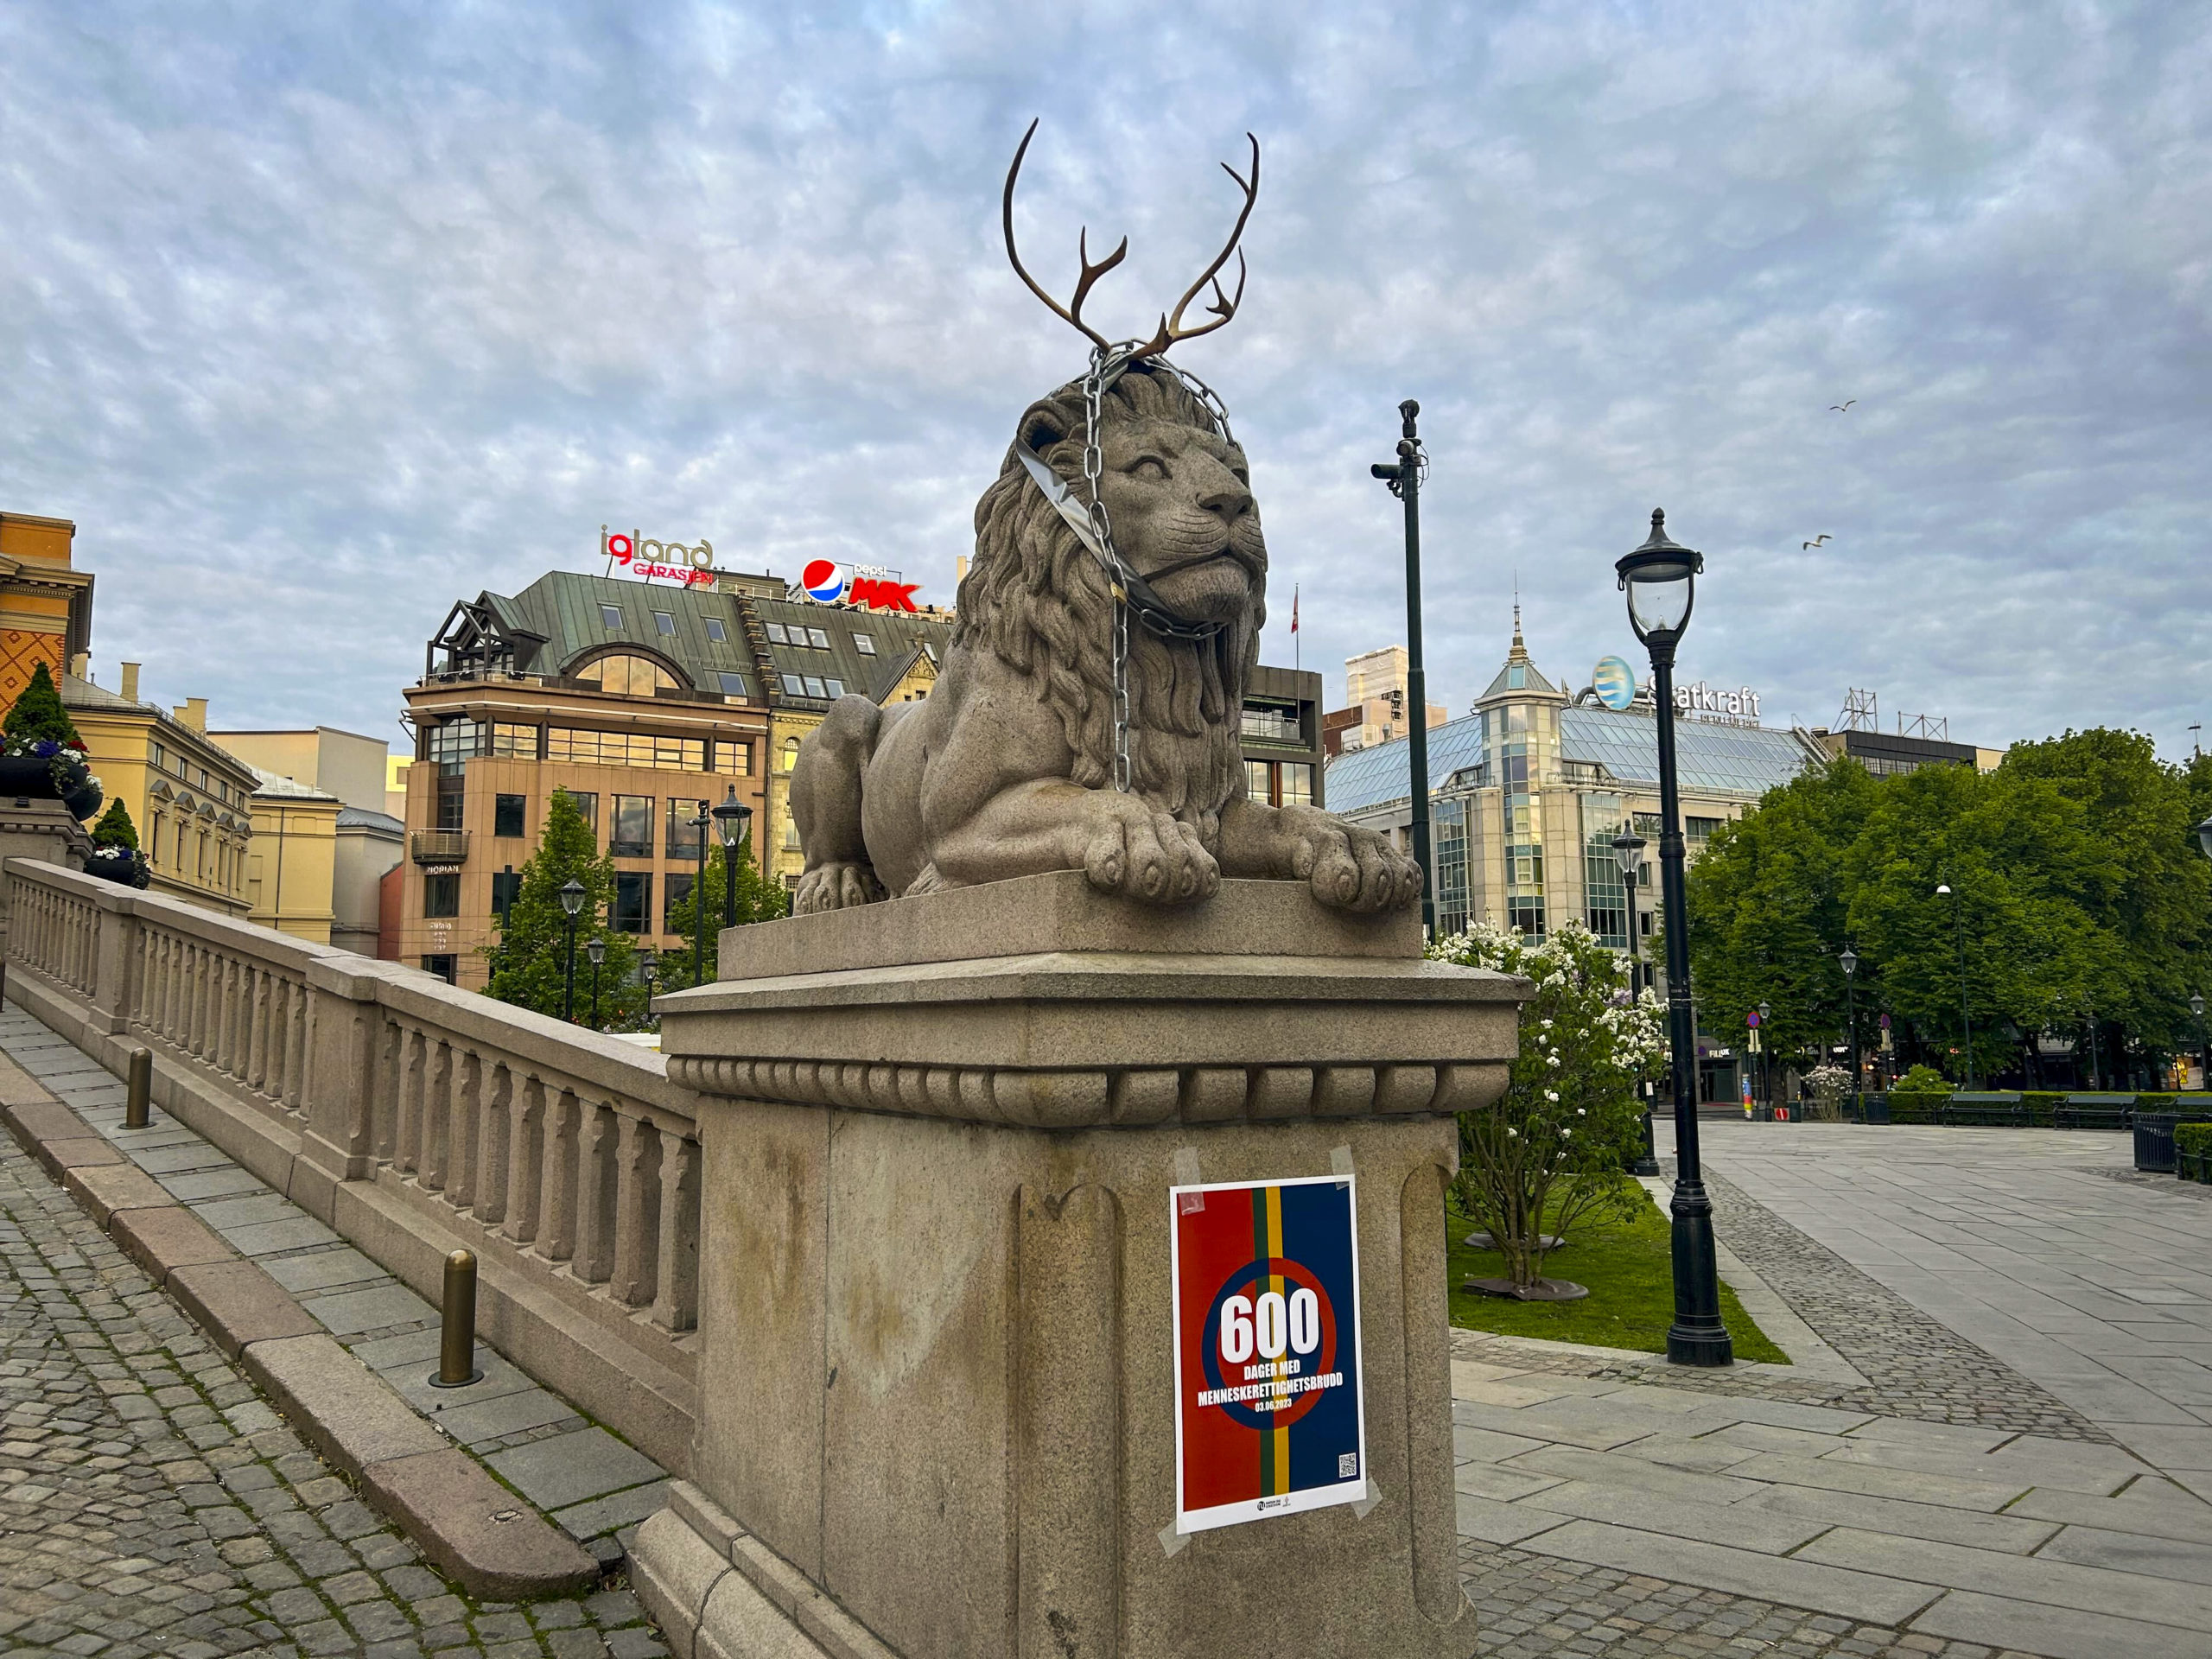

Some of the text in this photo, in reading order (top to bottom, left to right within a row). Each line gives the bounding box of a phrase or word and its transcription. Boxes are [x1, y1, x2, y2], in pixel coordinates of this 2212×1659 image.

[601, 524, 713, 569] igland
[633, 563, 714, 585] GARASJEN
[854, 563, 887, 576] pepsi
[849, 576, 923, 613] MAX
[1221, 1287, 1319, 1363] 600
[1243, 1359, 1300, 1381] DAGER MED
[1198, 1372, 1343, 1407] MENNESKERETTIGHETSBRUDD
[1255, 1398, 1293, 1413] 03.06.2023
